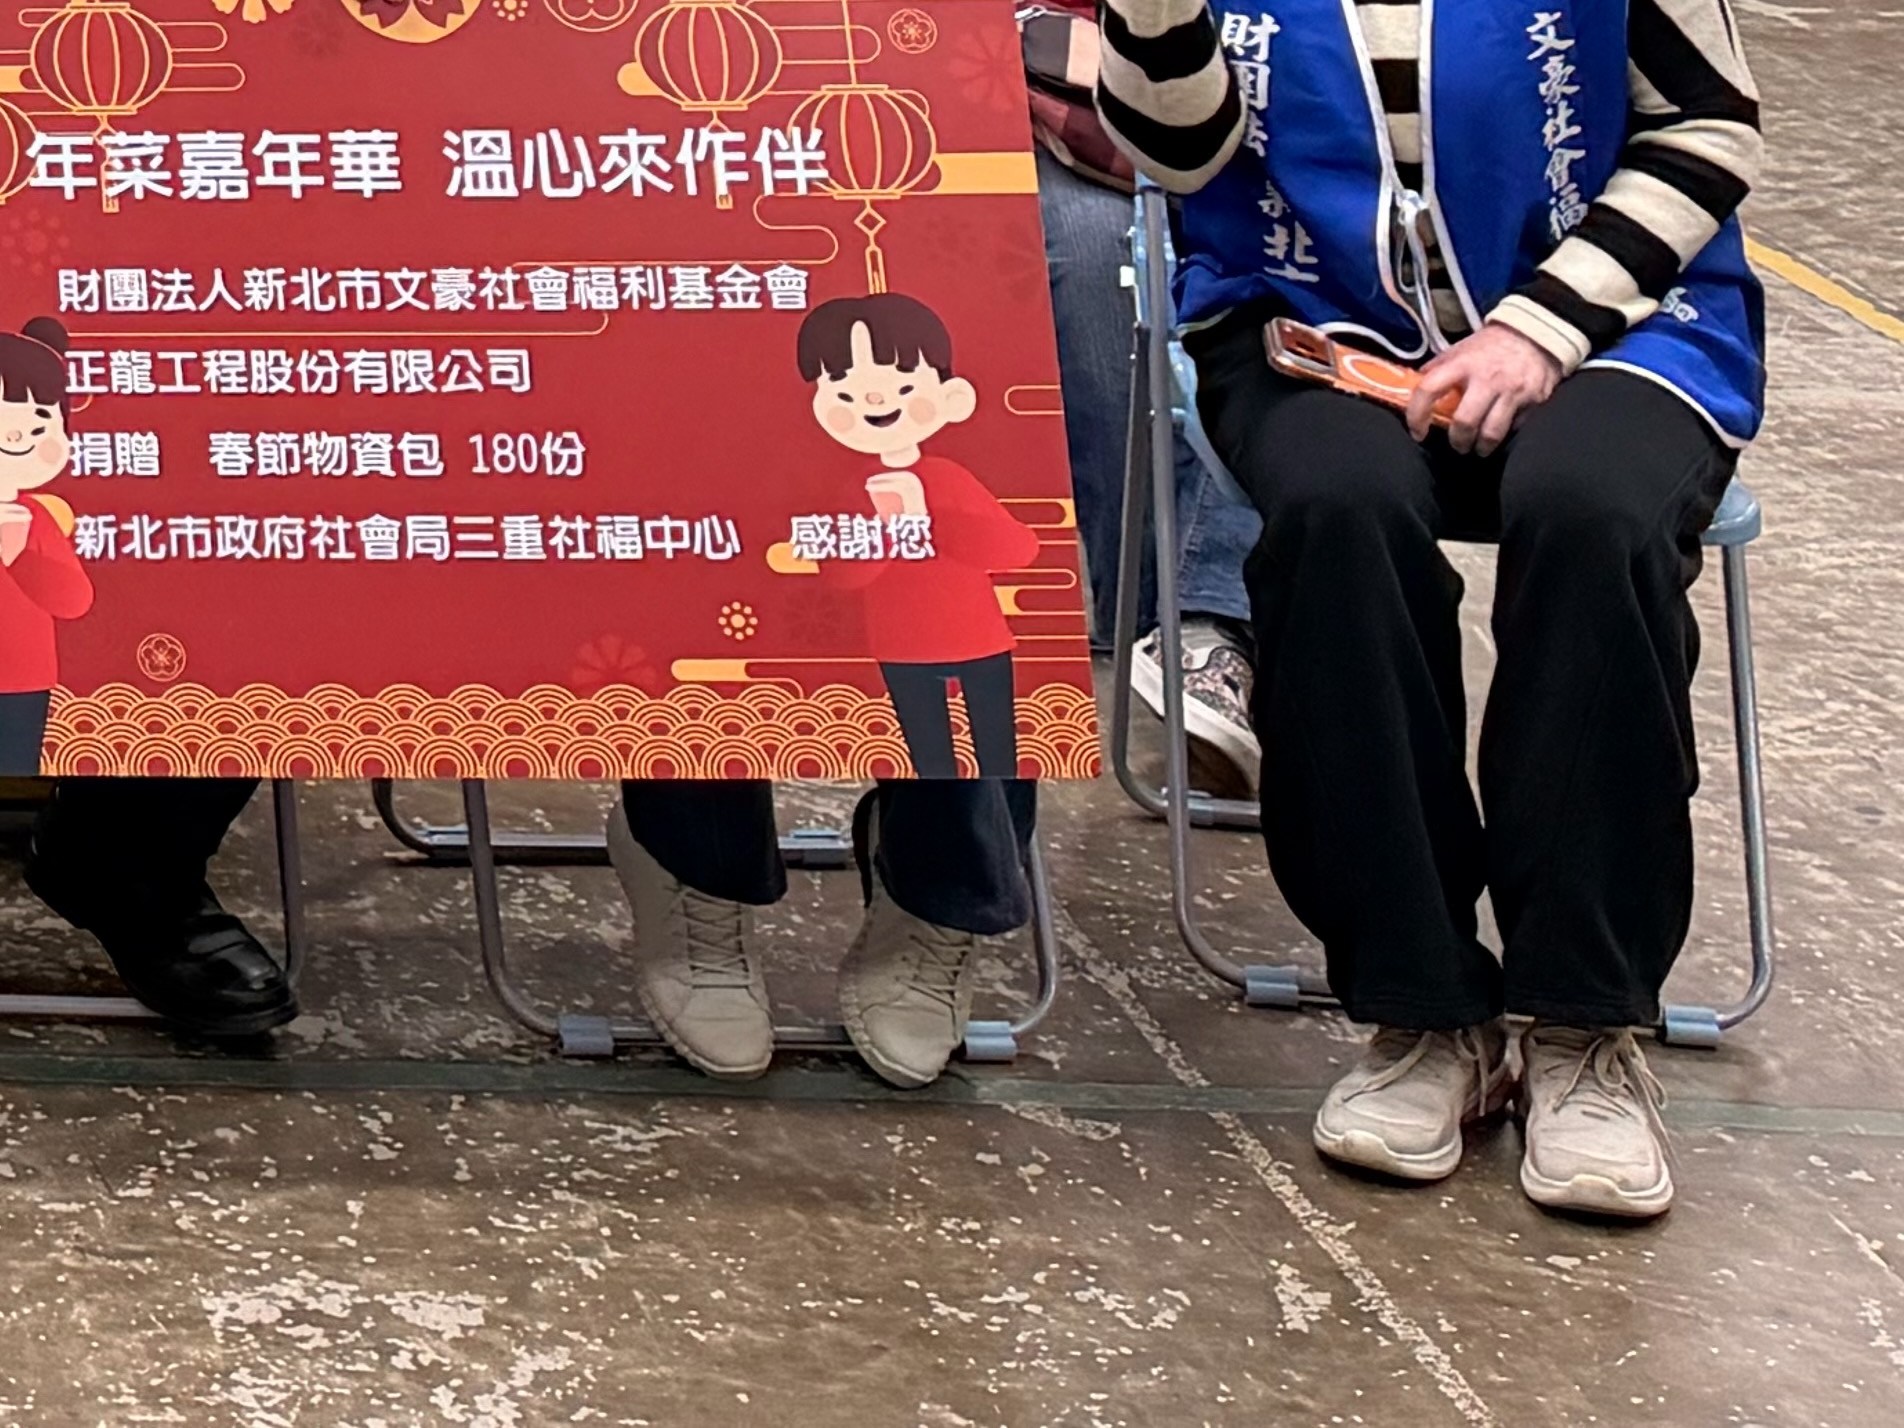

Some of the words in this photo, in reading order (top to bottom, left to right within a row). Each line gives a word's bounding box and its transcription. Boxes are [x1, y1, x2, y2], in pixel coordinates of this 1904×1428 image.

[26, 129, 402, 200] 年菜嘉年華
[442, 126, 829, 198] 溫心來作伴
[58, 265, 809, 313] 財團法人新北市文豪社會福利基金會
[64, 348, 531, 395] 正龍工程股份有限公司
[68, 432, 160, 477] 捐贈
[209, 431, 445, 477] 春節物資包
[469, 431, 586, 477] 180份
[75, 513, 741, 561] 新北市政府社會局三重社福中心
[789, 513, 935, 560] 感謝您
